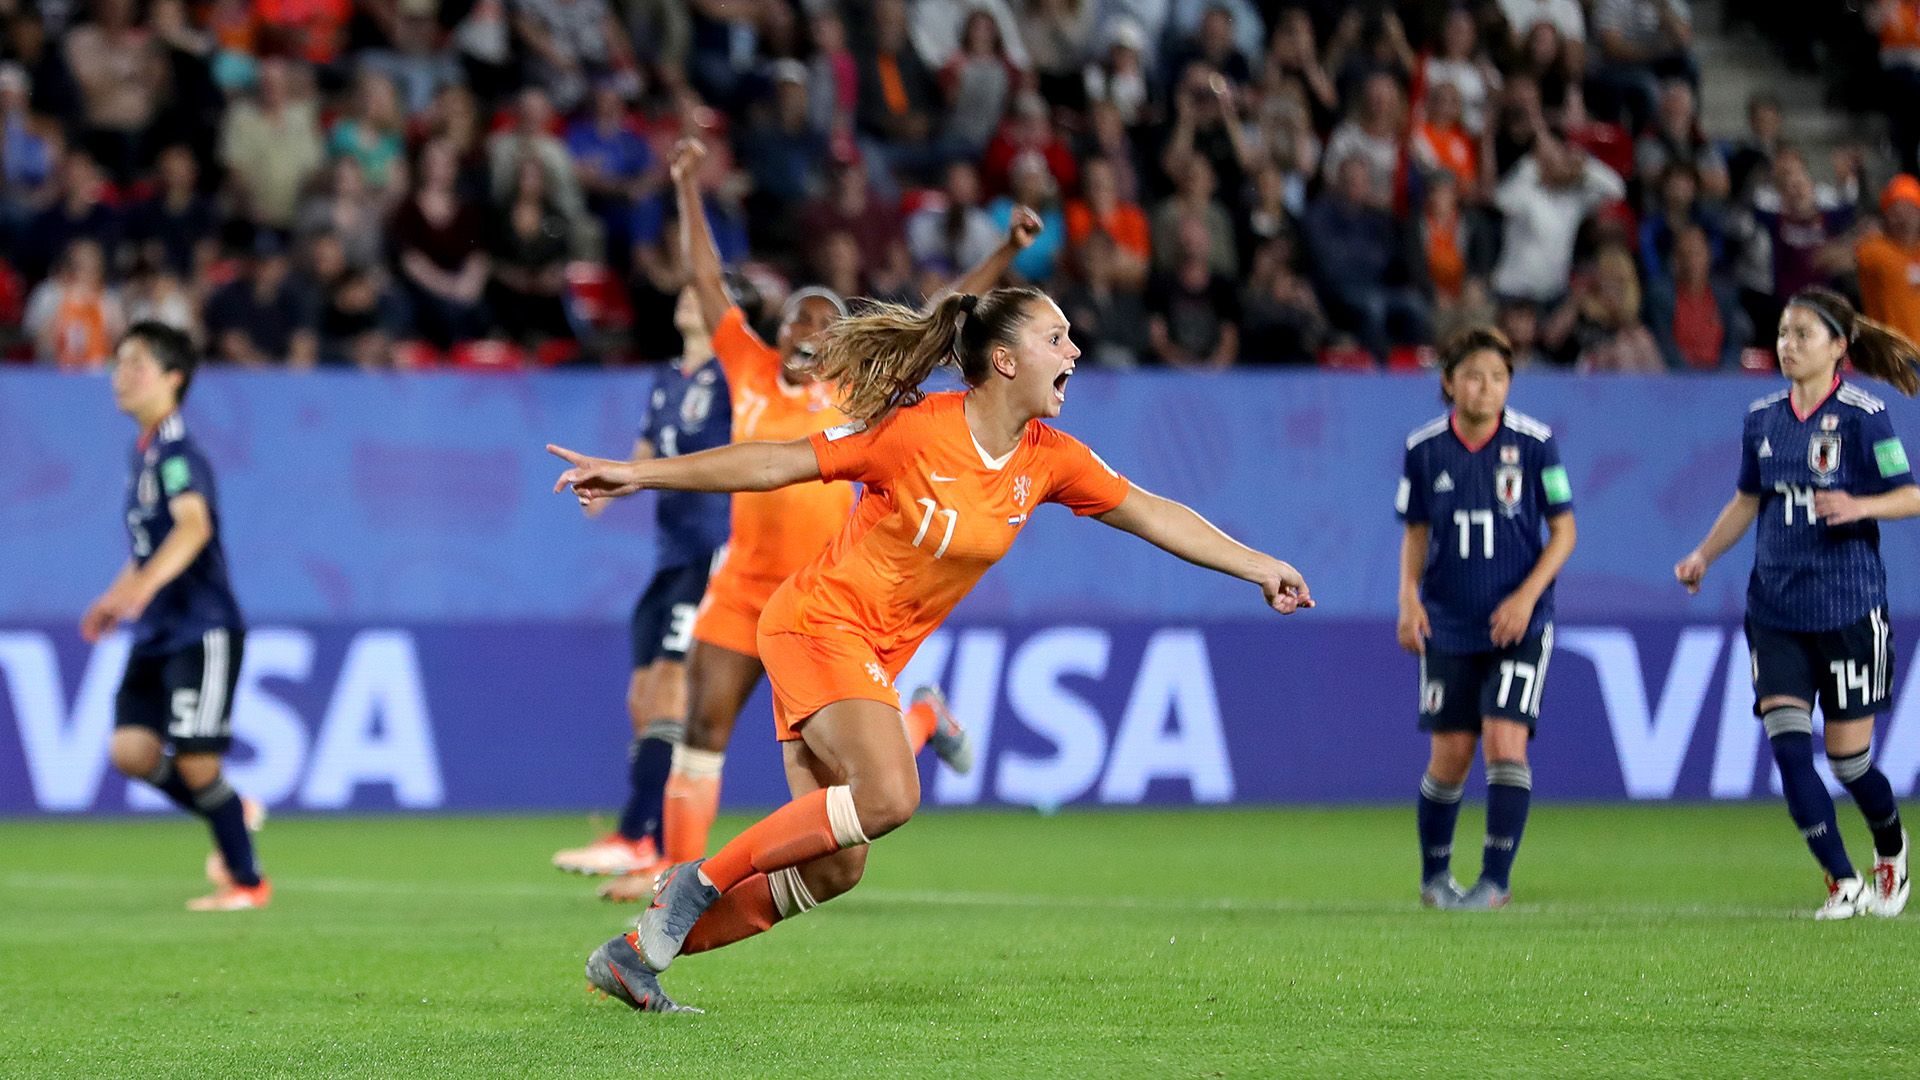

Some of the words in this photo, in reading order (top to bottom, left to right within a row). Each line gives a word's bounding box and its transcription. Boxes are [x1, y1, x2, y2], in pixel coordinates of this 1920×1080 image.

[912, 497, 958, 559] 11
[1774, 480, 1817, 526] 14
[1453, 509, 1494, 559] 17
[661, 603, 698, 652] 3
[1496, 660, 1536, 714] 17
[1829, 658, 1870, 710] 14
[0, 628, 446, 810] VSA
[168, 687, 199, 738] 5
